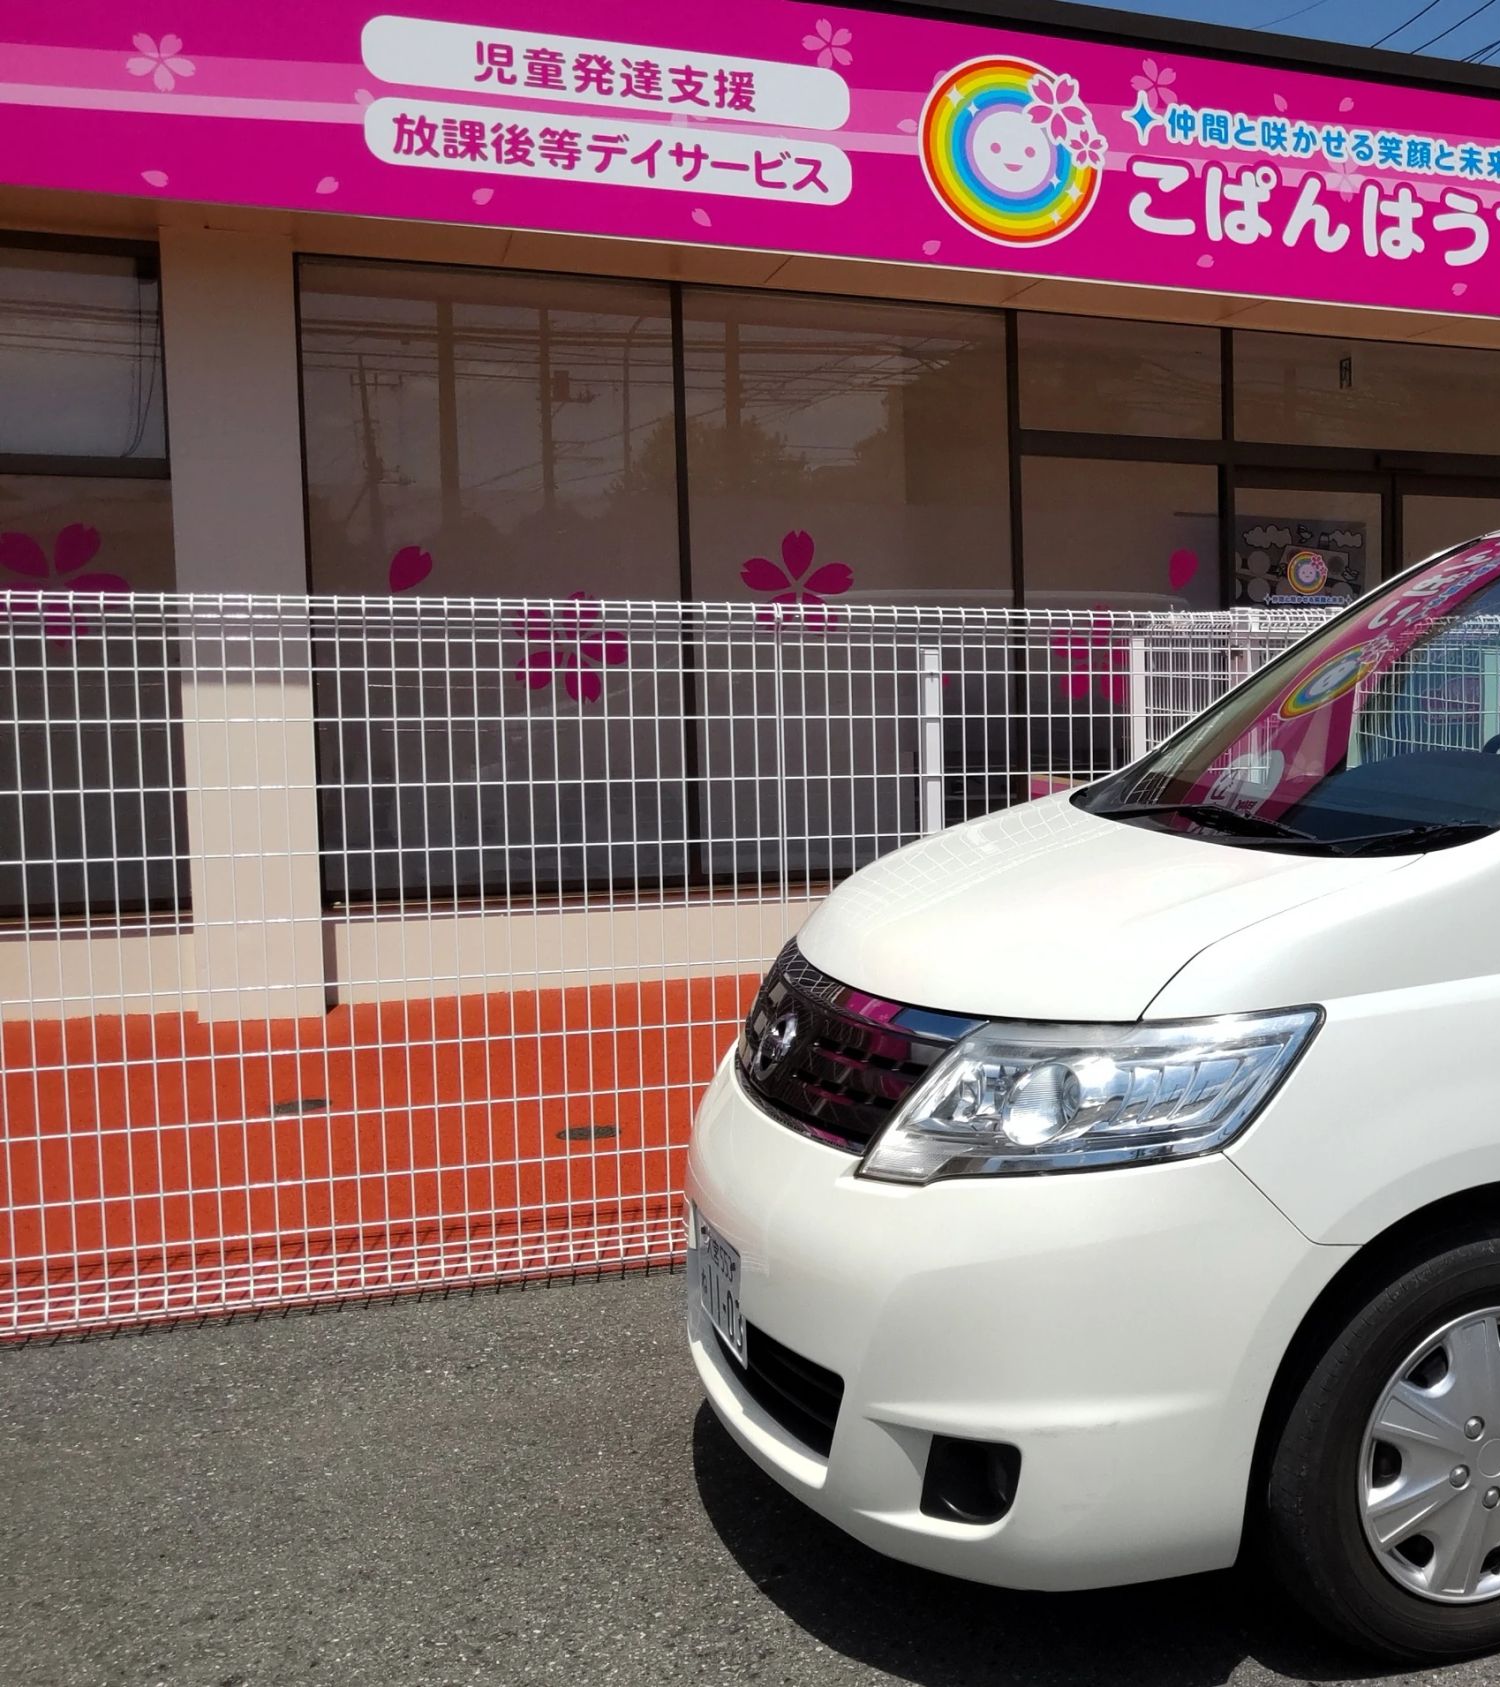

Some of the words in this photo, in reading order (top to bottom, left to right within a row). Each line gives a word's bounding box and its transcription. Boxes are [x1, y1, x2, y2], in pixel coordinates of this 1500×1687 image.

[474, 40, 757, 113] 児童発達支援
[392, 112, 830, 195] 放課後等デイサービス
